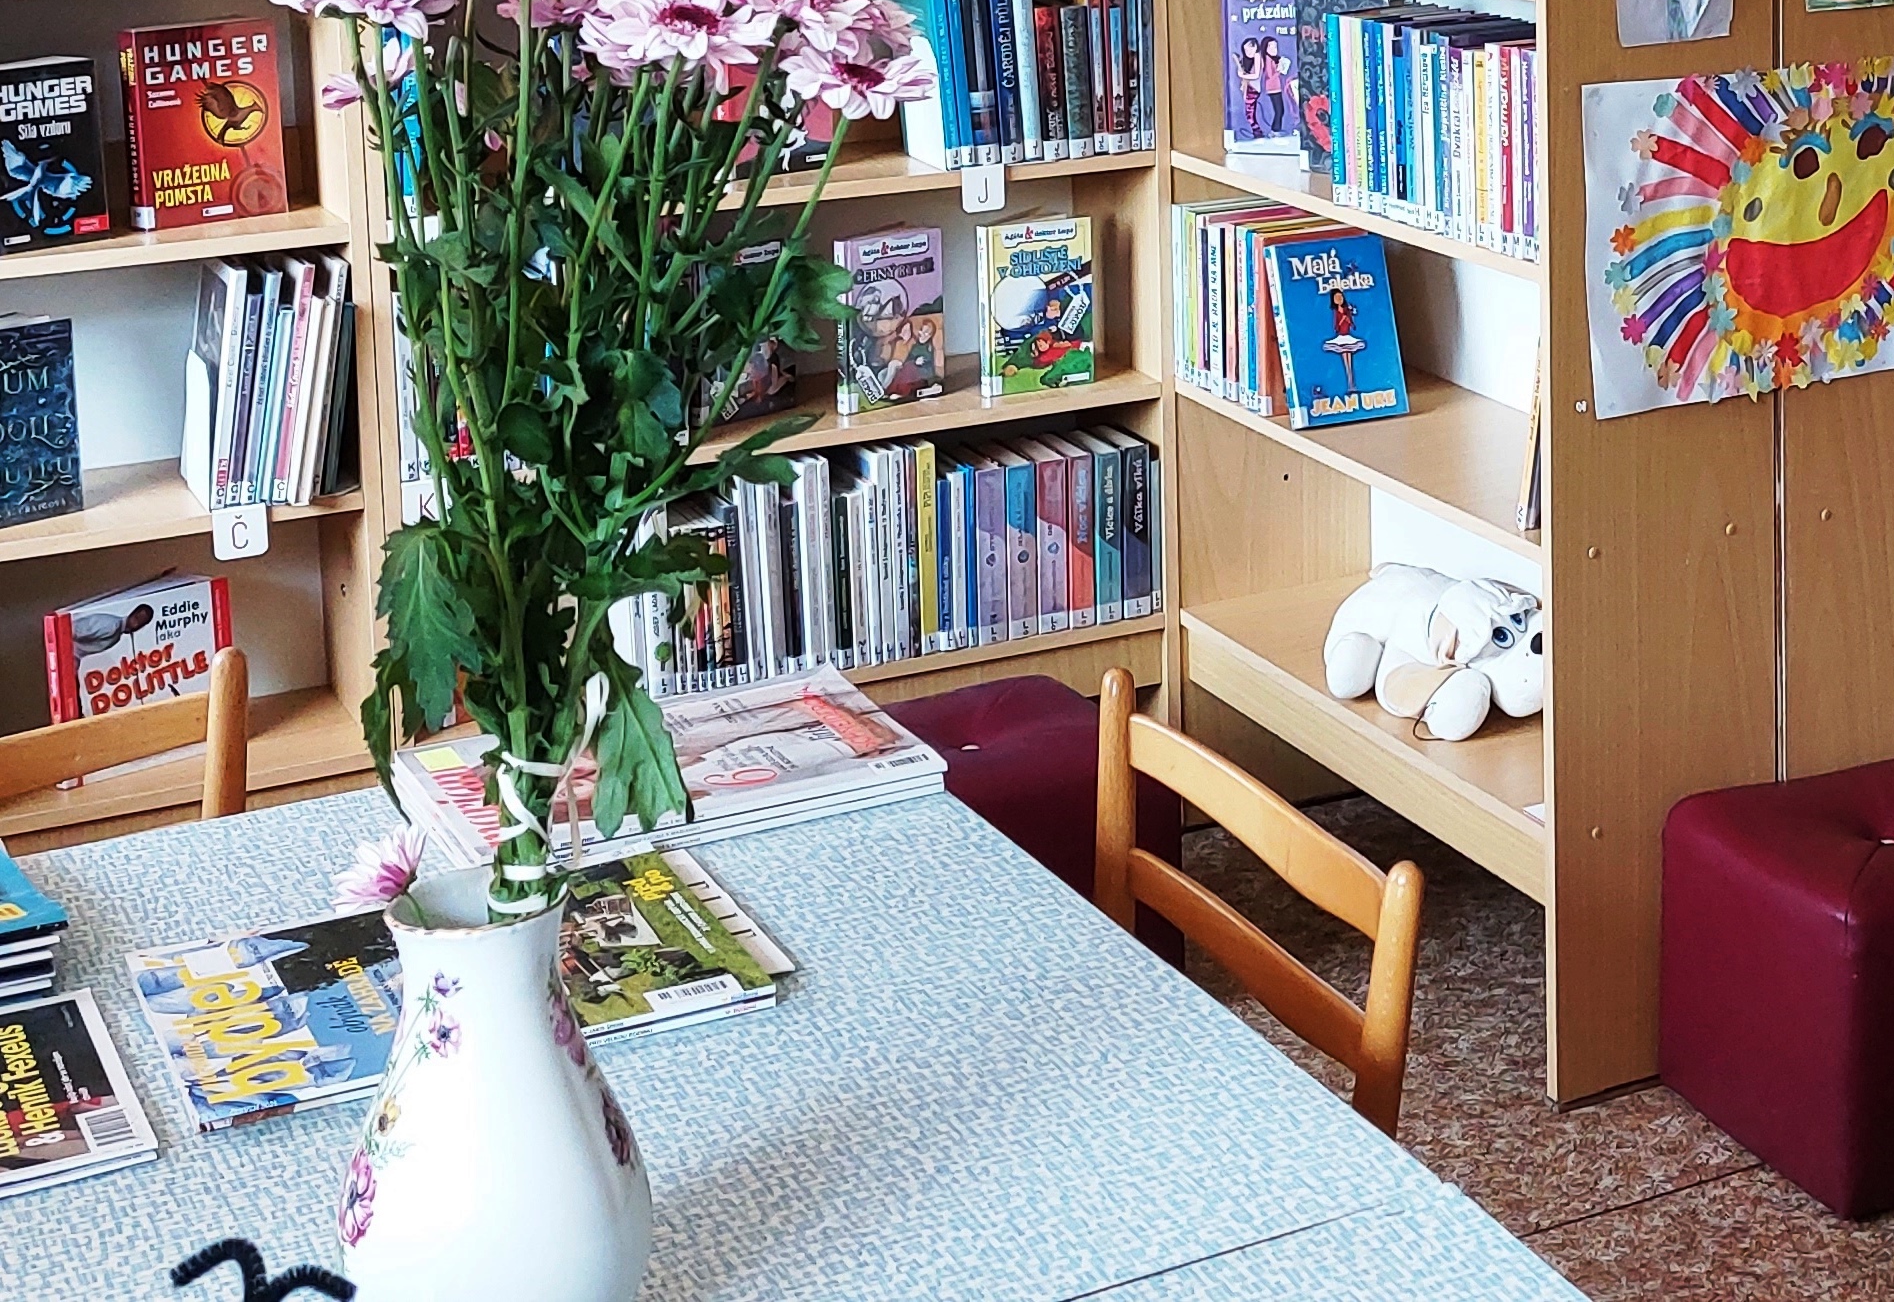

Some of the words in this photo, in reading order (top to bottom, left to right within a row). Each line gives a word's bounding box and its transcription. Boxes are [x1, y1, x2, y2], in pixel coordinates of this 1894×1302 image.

[144, 34, 266, 64] HUNGER
[146, 58, 253, 84] GAMES
[0, 96, 86, 122] GAMES
[18, 122, 36, 140] Síla
[153, 158, 230, 188] VRAŽEDNÁ
[155, 184, 214, 209] POMSTA
[978, 178, 988, 204] J
[1011, 258, 1082, 278] OHROŽENÍ
[1287, 248, 1341, 280] Malá
[1318, 272, 1374, 295] baletka
[1311, 396, 1358, 416] JEAN
[231, 514, 249, 549] Č
[162, 600, 200, 616] Eddie
[156, 612, 208, 632] Murphy
[84, 644, 174, 694] Doktor
[91, 650, 208, 715] DOLITTLE
[1, 1024, 40, 1085] Fexeus
[8, 1067, 60, 1136] Henrik
[26, 1131, 65, 1146] &
